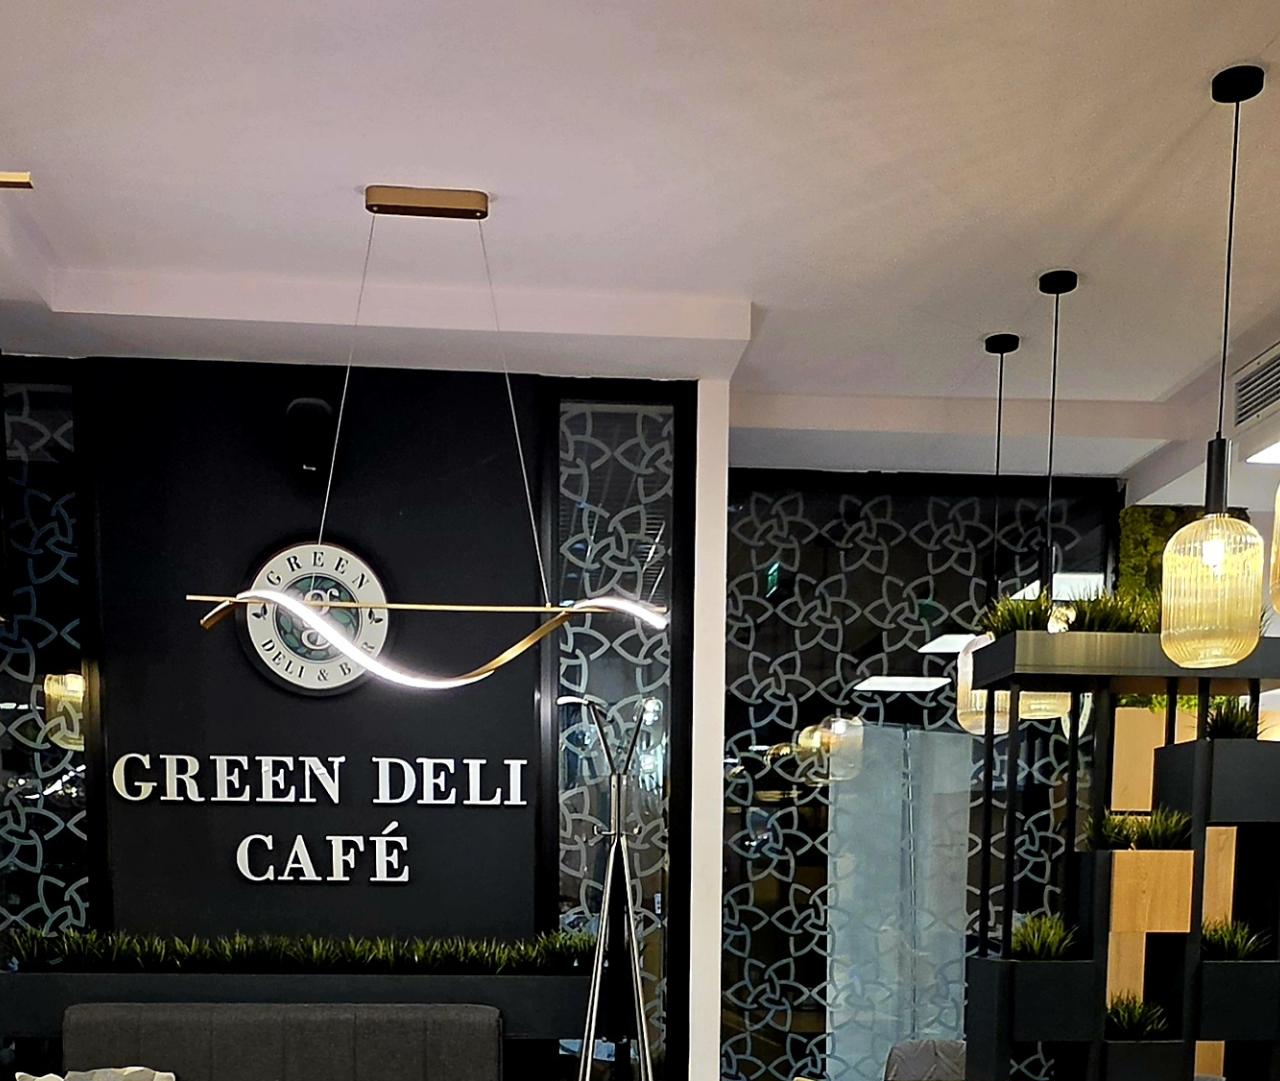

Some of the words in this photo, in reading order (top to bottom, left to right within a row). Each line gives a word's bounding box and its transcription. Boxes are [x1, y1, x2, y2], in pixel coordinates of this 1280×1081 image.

[266, 551, 370, 590] GREEN
[261, 639, 305, 679] DELI
[317, 668, 329, 682] &
[339, 641, 376, 677] BR
[112, 752, 346, 804] GREEN
[372, 756, 528, 806] DELI
[236, 821, 410, 883] CAFÉ
